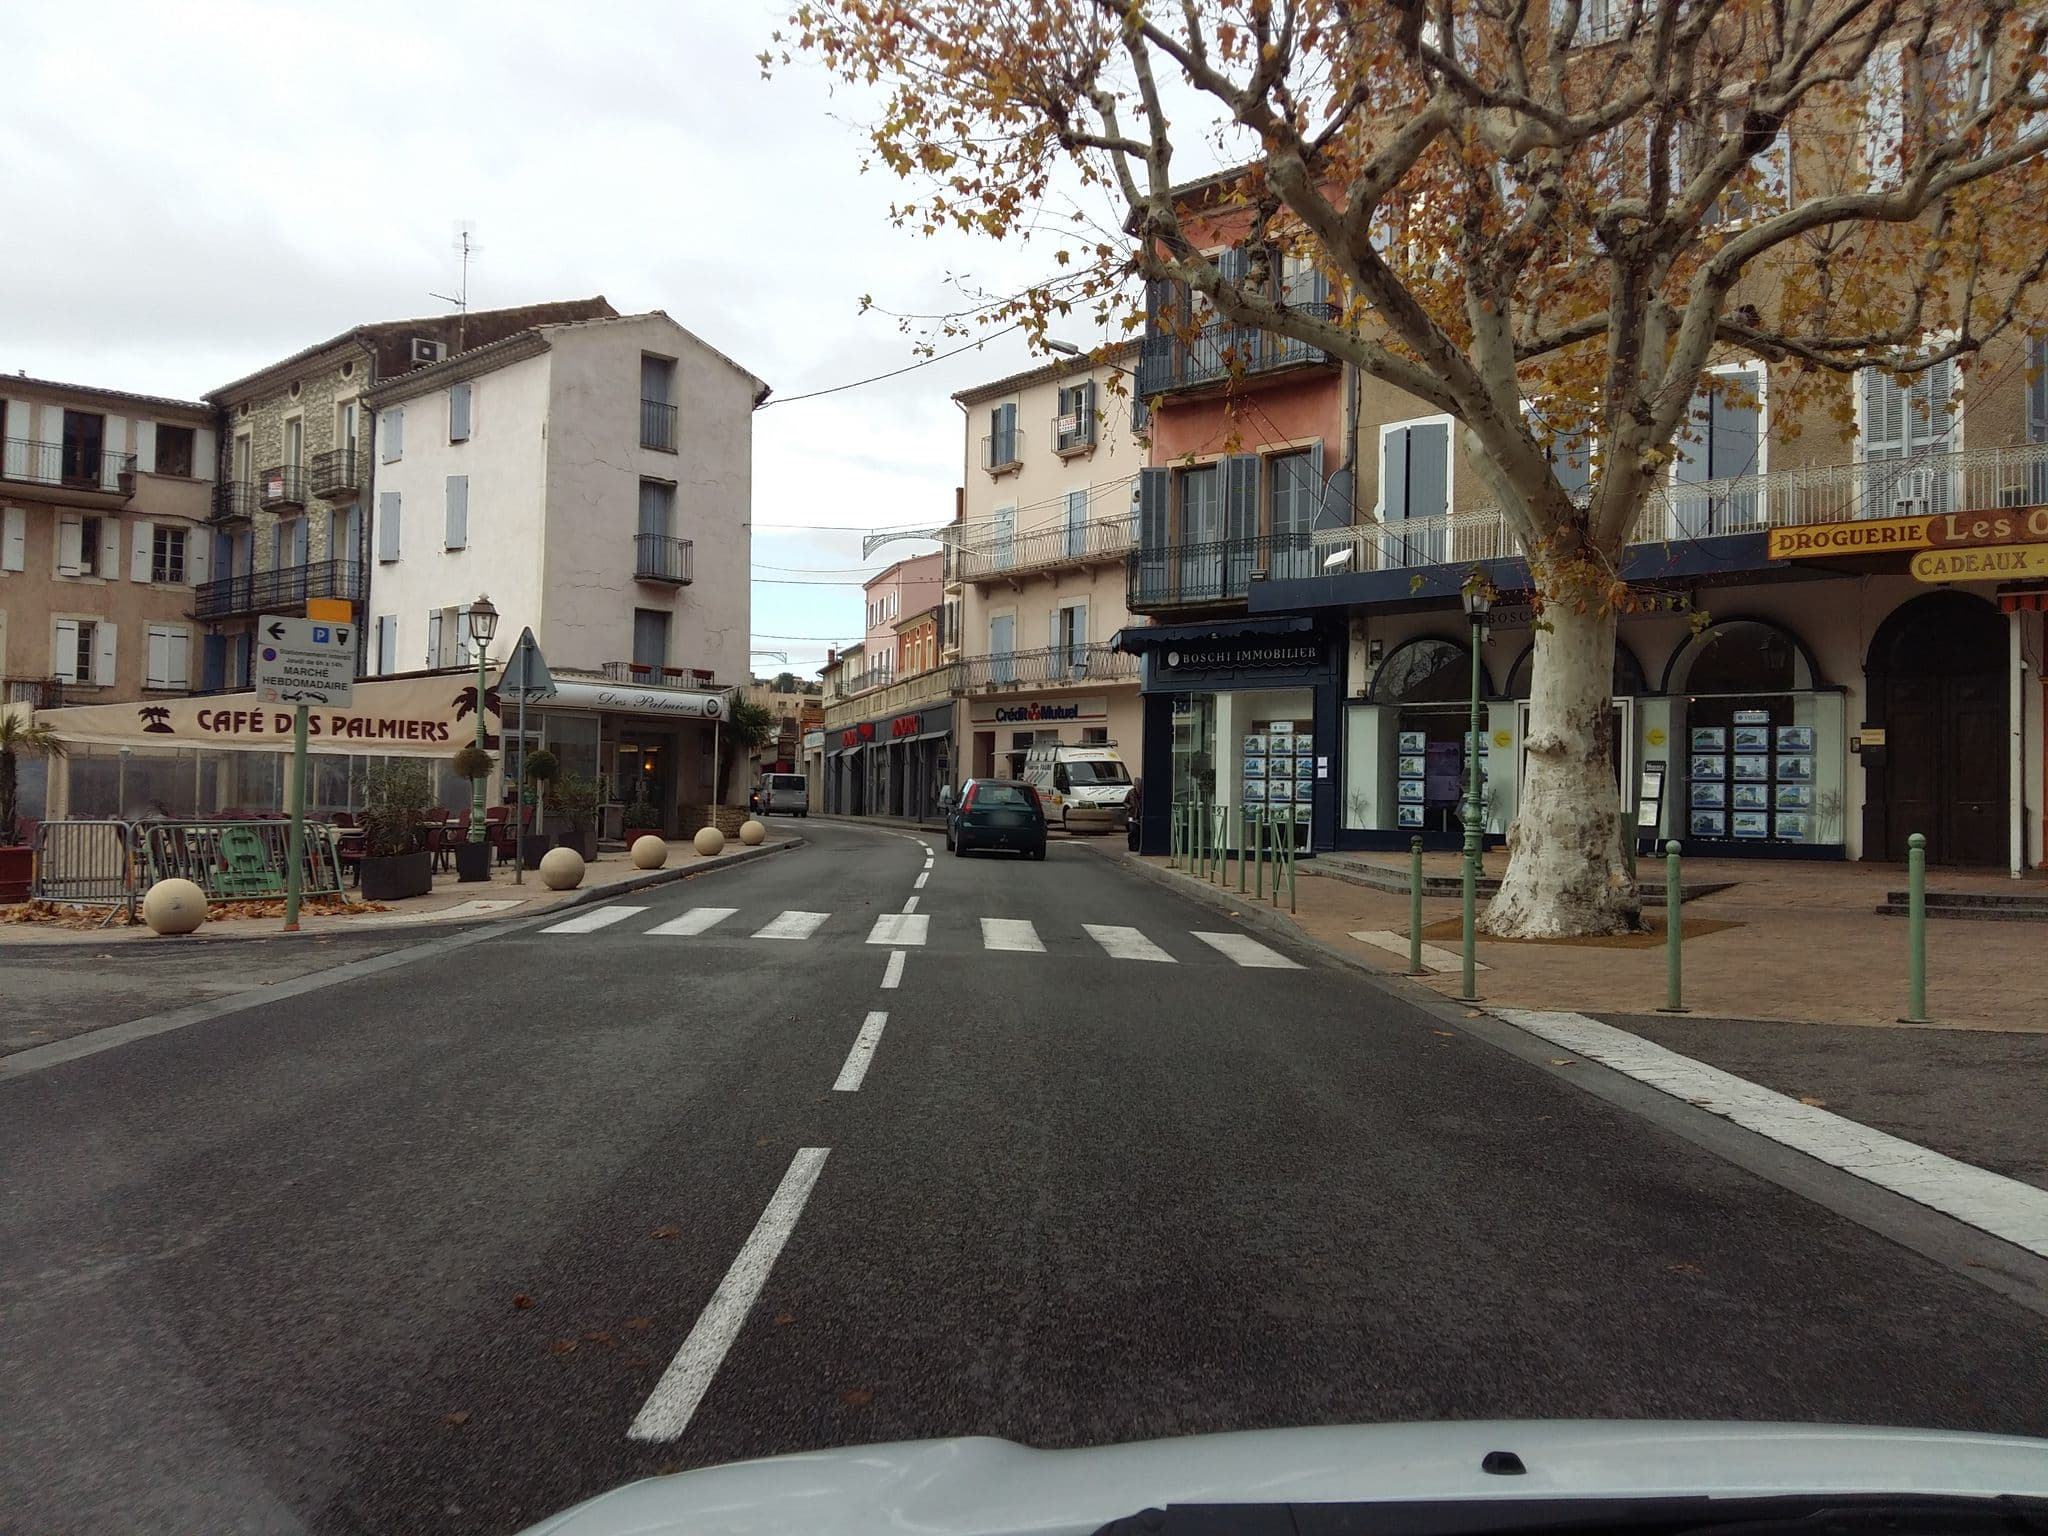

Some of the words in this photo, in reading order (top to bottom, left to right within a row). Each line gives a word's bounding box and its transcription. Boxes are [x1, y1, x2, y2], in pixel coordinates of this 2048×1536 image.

[1778, 524, 1923, 551] DROGUERIE
[1944, 514, 2011, 541] Les
[1917, 551, 2028, 577] CADEAUX
[1183, 652, 1231, 664] BOSCHI
[1236, 646, 1317, 661] IMMOBILIER
[283, 665, 329, 678] MARCHÉ
[262, 676, 348, 691] HEBDOMADAIRE
[598, 691, 626, 707] Des
[633, 694, 698, 712] Palmiers
[995, 707, 1028, 721] Crédit
[1041, 704, 1078, 720] Mutuel
[197, 707, 265, 734] CAFÉ
[274, 713, 322, 735] DS
[331, 715, 449, 743] PALMIERS
